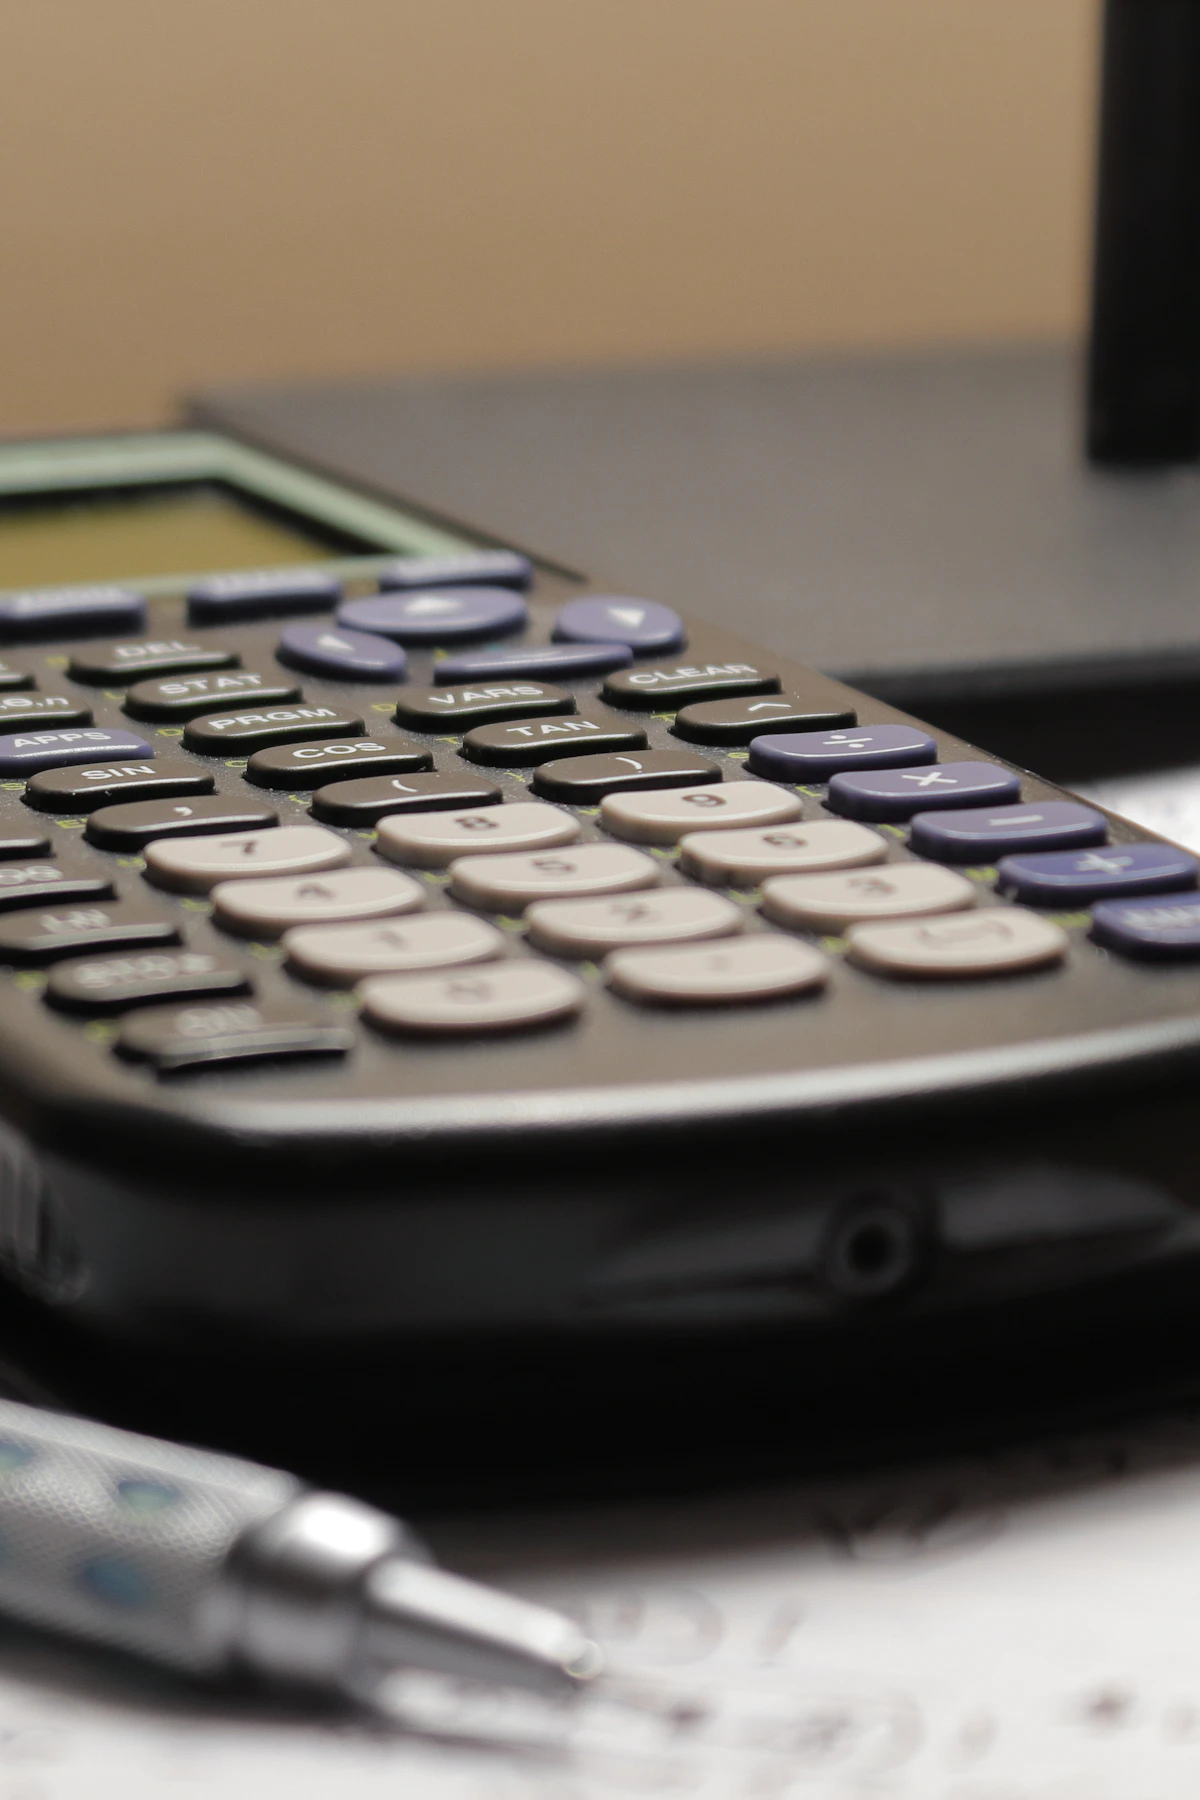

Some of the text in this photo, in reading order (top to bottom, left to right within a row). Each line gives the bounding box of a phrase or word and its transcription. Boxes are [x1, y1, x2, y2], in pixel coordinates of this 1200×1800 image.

[114, 640, 202, 660] DEL
[628, 663, 759, 686] CLEAR
[159, 674, 262, 695] STAT
[428, 686, 544, 704] VARS
[208, 708, 338, 730] PRGM
[506, 719, 603, 737] TAN
[14, 730, 113, 748] APPS
[292, 741, 388, 758] COS
[80, 765, 157, 781] SIN
